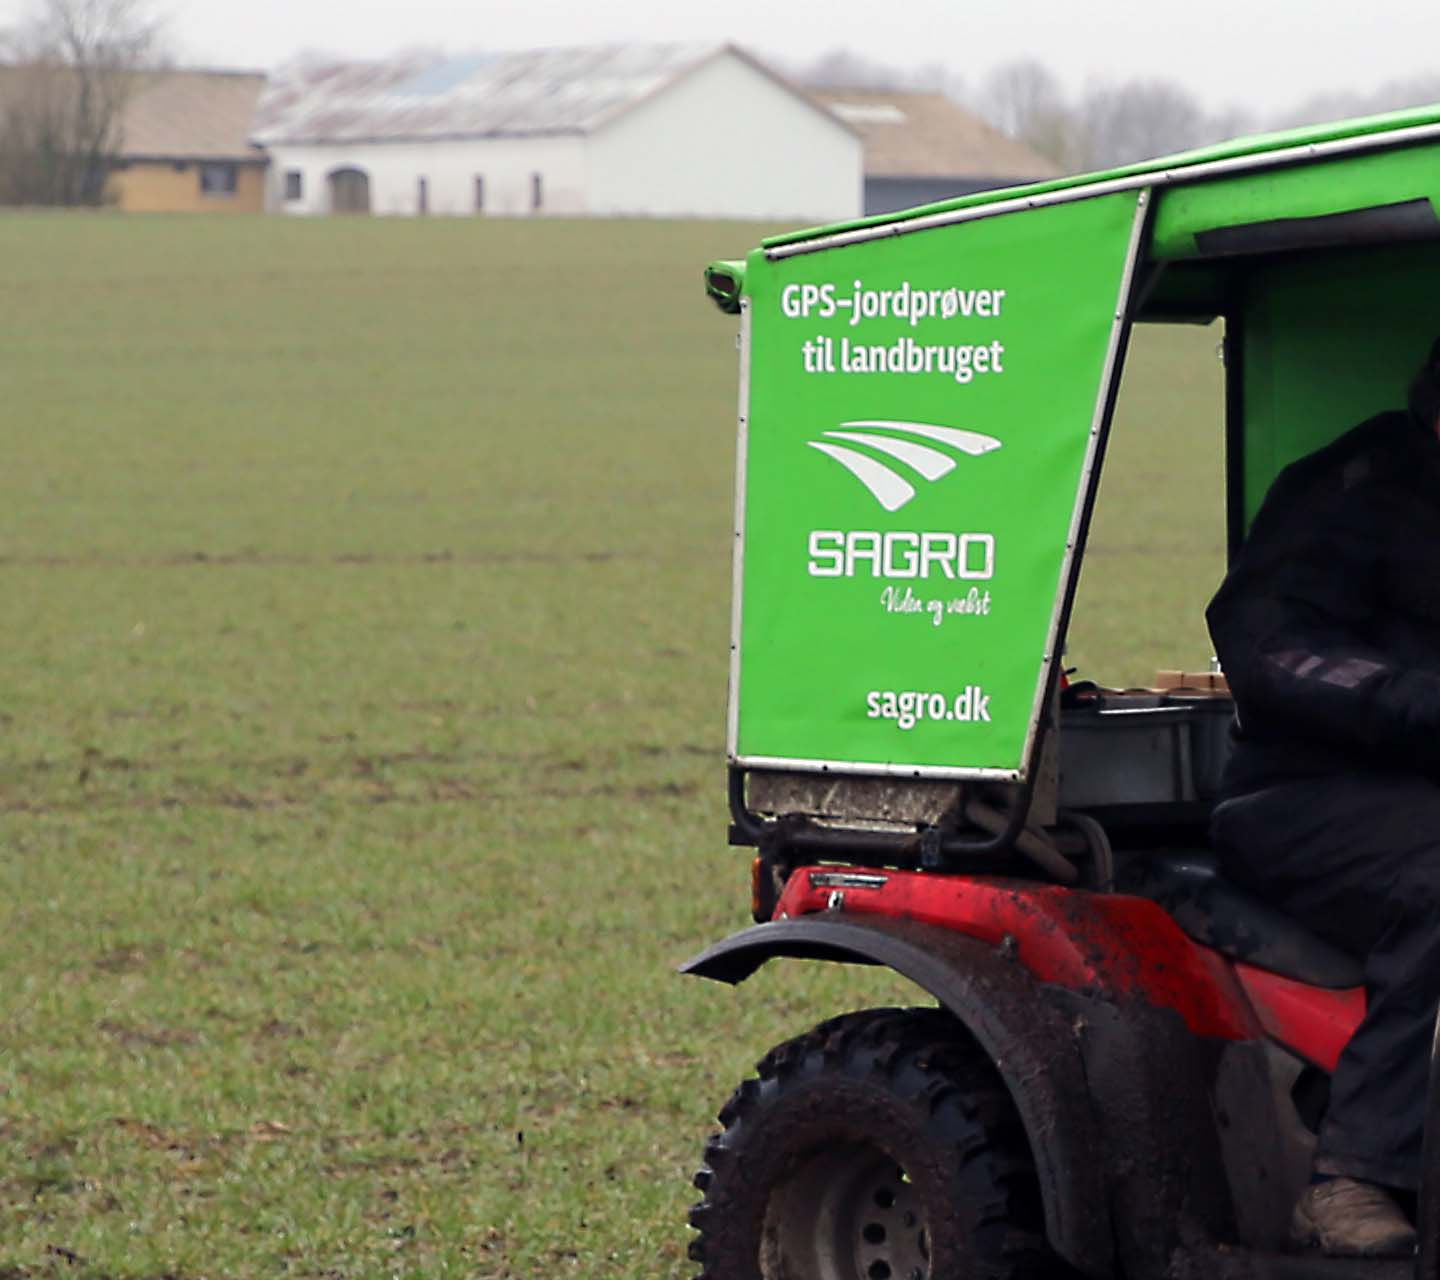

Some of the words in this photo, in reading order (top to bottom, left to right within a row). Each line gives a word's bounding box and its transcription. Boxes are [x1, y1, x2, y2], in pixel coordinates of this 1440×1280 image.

[782, 280, 1006, 327] GPS-jordprøver
[801, 336, 837, 373] til
[840, 337, 1004, 385] landbruget
[807, 530, 995, 580] SAGRO
[926, 599, 945, 627] og
[866, 685, 992, 730] sagro.dk
